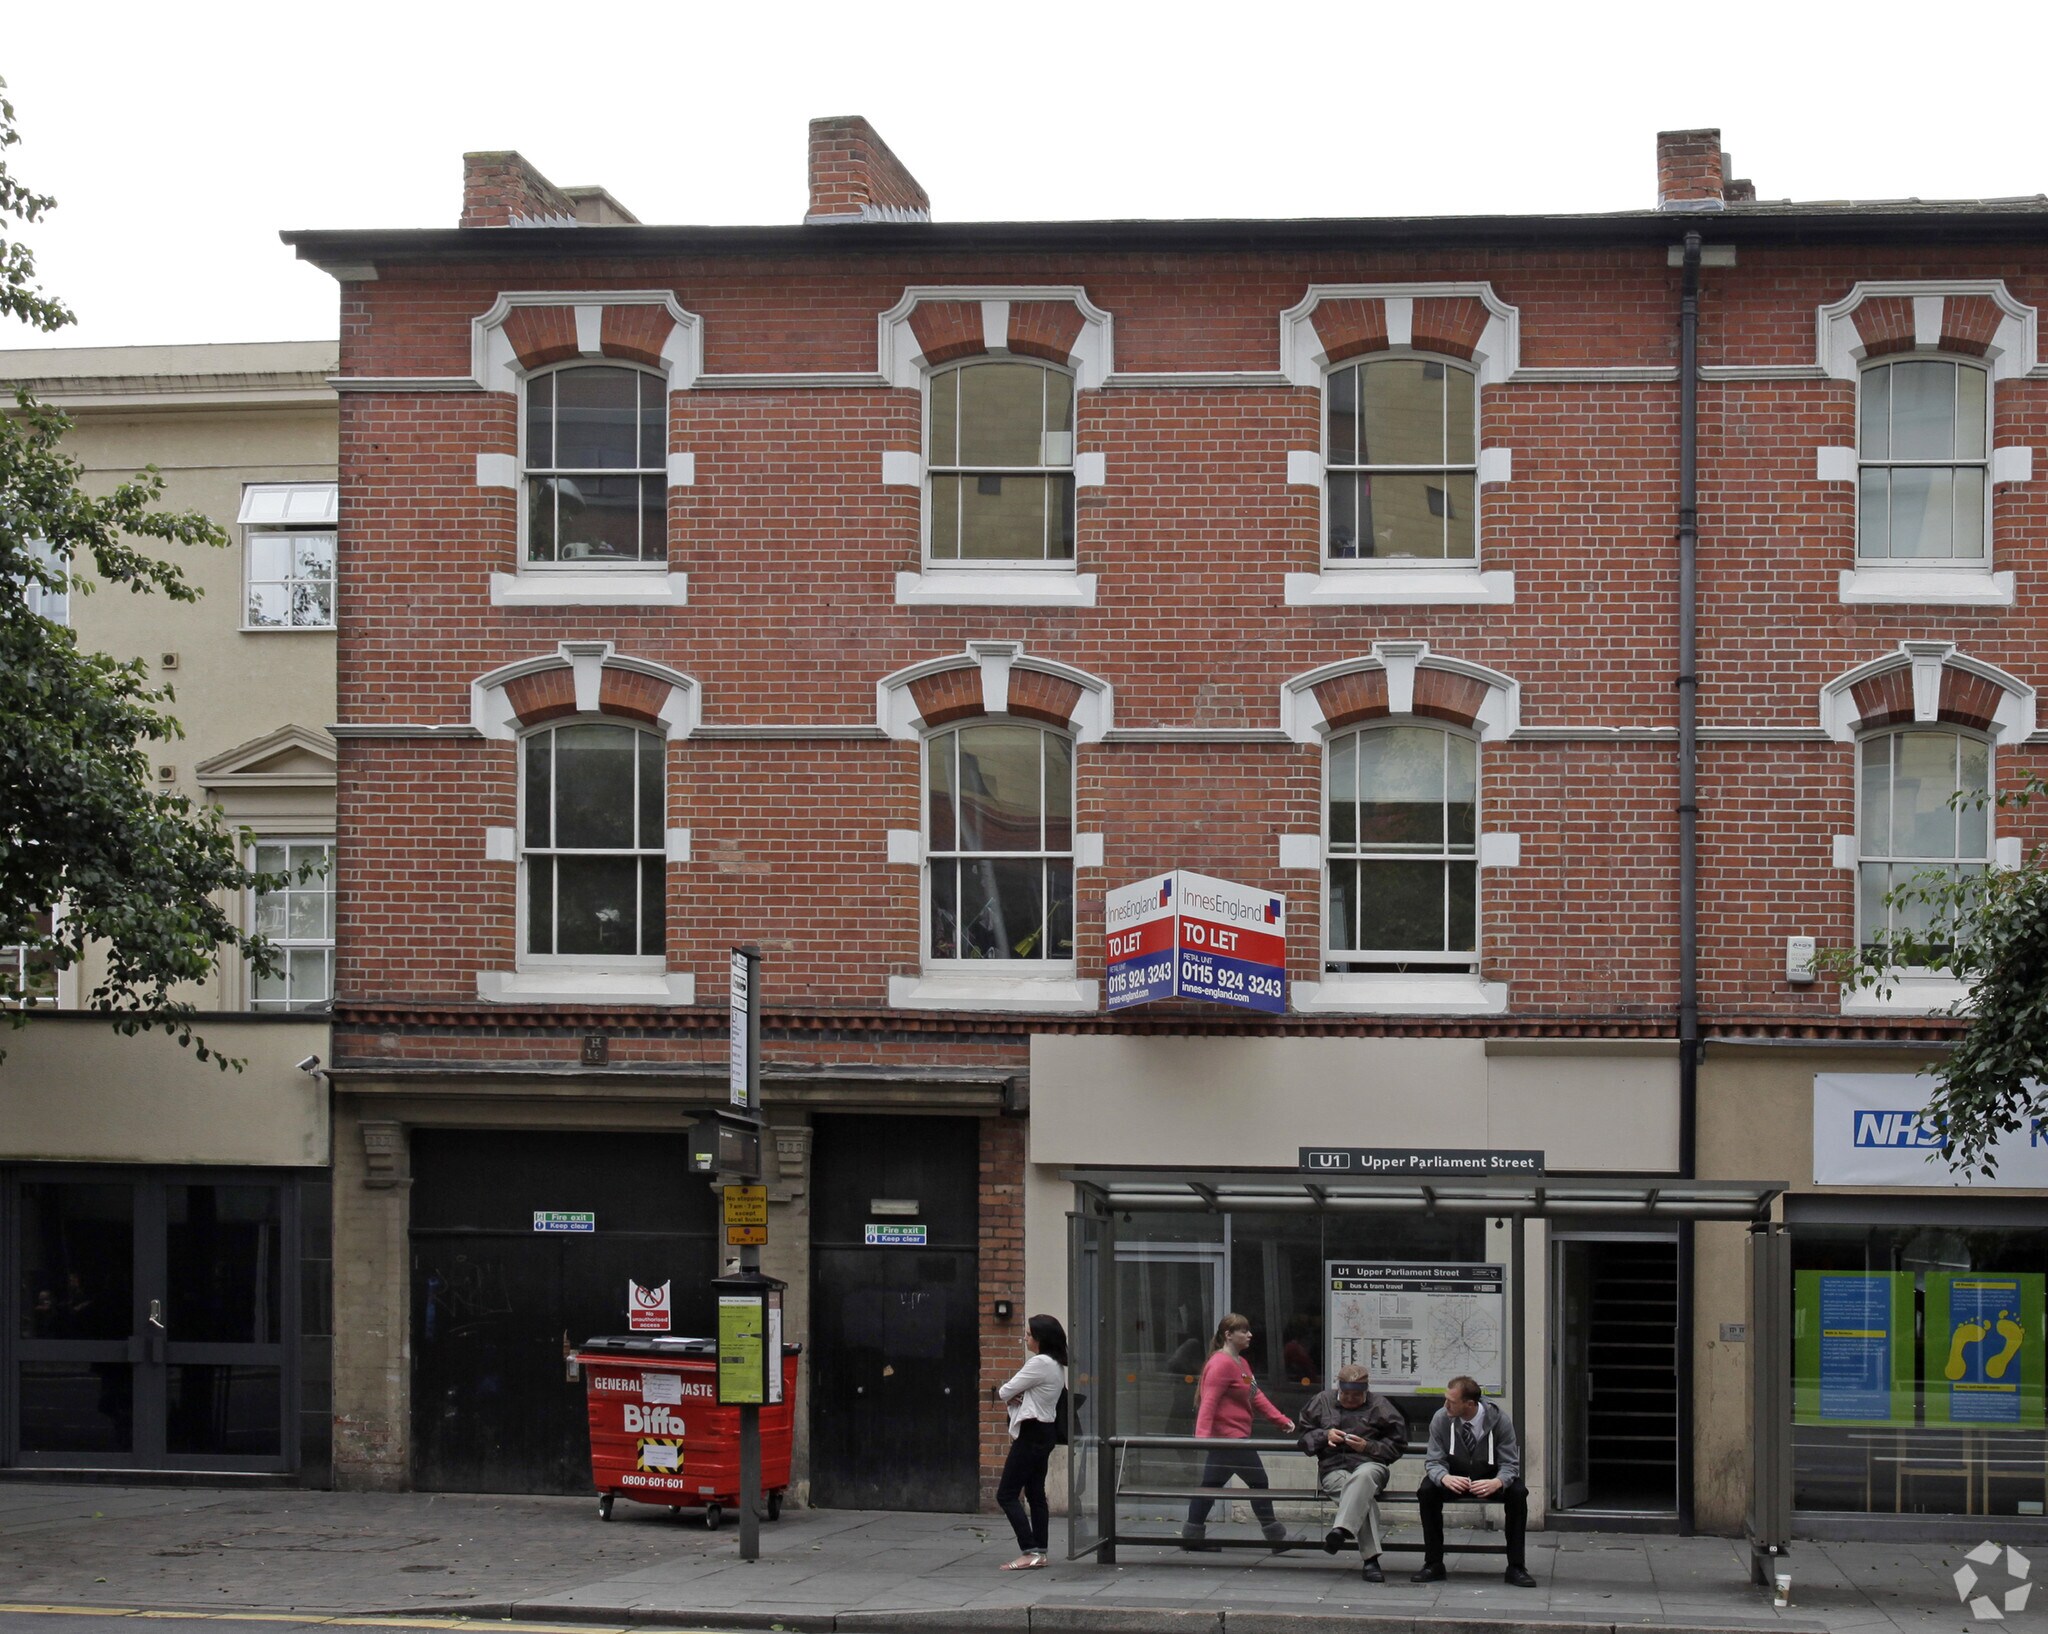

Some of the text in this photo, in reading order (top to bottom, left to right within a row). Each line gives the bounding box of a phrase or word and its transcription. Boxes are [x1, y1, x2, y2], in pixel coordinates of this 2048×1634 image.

[1108, 892, 1158, 922] InnesEngland
[1183, 888, 1262, 922] InnesEngland
[1109, 932, 1142, 957] TO LET
[1184, 922, 1238, 951] TO LET
[1183, 952, 1213, 964] RETAIL UNIT
[1109, 962, 1172, 994] 0115 924 3243
[1182, 962, 1282, 998] 0115 924 3243
[1108, 988, 1149, 1005] innes-england.com
[1182, 982, 1250, 1002] innes-england.com
[1319, 1154, 1534, 1170] U1 Upper Parliament Street
[1357, 1268, 1382, 1277] Upper
[1385, 1268, 1432, 1276] Parliament
[594, 1377, 642, 1392] GENERAL
[681, 1382, 713, 1397] ASTE
[624, 1404, 686, 1436] Biffa
